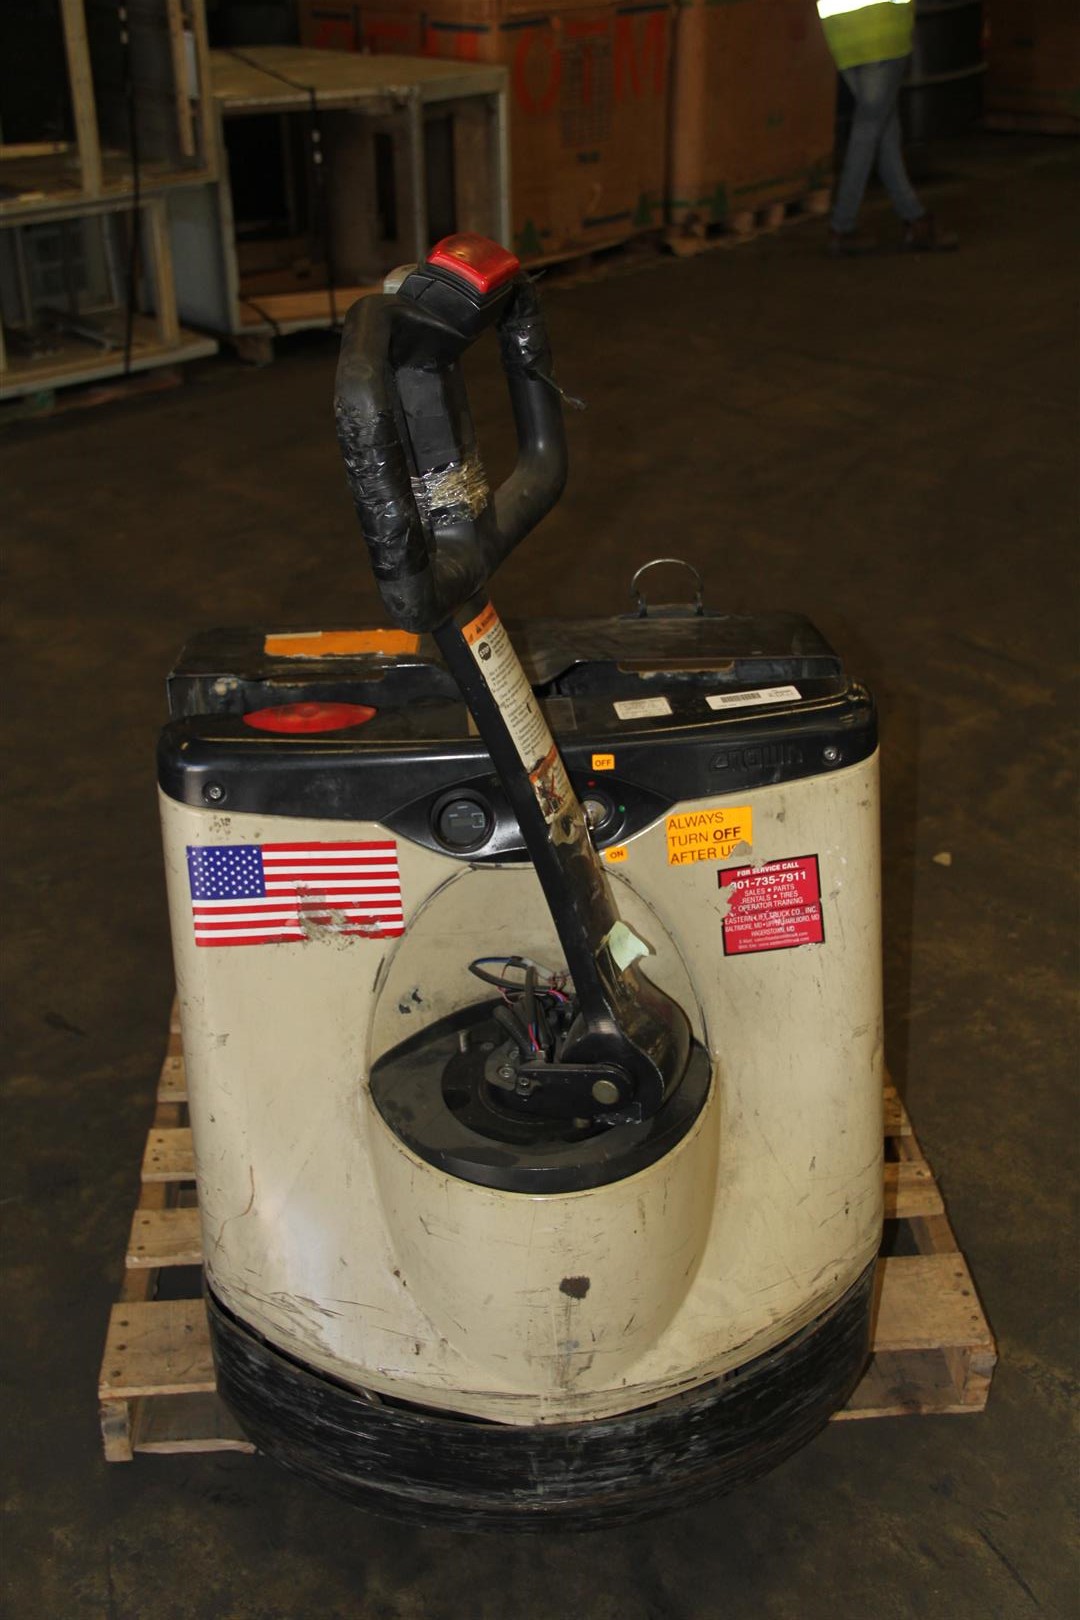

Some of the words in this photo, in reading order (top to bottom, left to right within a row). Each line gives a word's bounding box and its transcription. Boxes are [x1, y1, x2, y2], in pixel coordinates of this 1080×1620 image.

[595, 759, 612, 767] OFF
[668, 811, 724, 831] ALWAYS
[669, 832, 709, 847] TURN
[713, 827, 742, 842] OFF
[609, 851, 624, 859] ON
[670, 847, 717, 864] AFTER
[737, 869, 751, 877] FOR
[752, 864, 780, 874] SERVICE
[782, 861, 799, 870] CALL
[729, 871, 806, 890] 301-735-7911
[741, 894, 771, 904] RENTALS
[780, 890, 799, 899] TIRES
[744, 887, 766, 897] SALES
[773, 883, 795, 892] PARTS
[738, 901, 772, 912] OPERATOR
[773, 896, 804, 907] TRAINING
